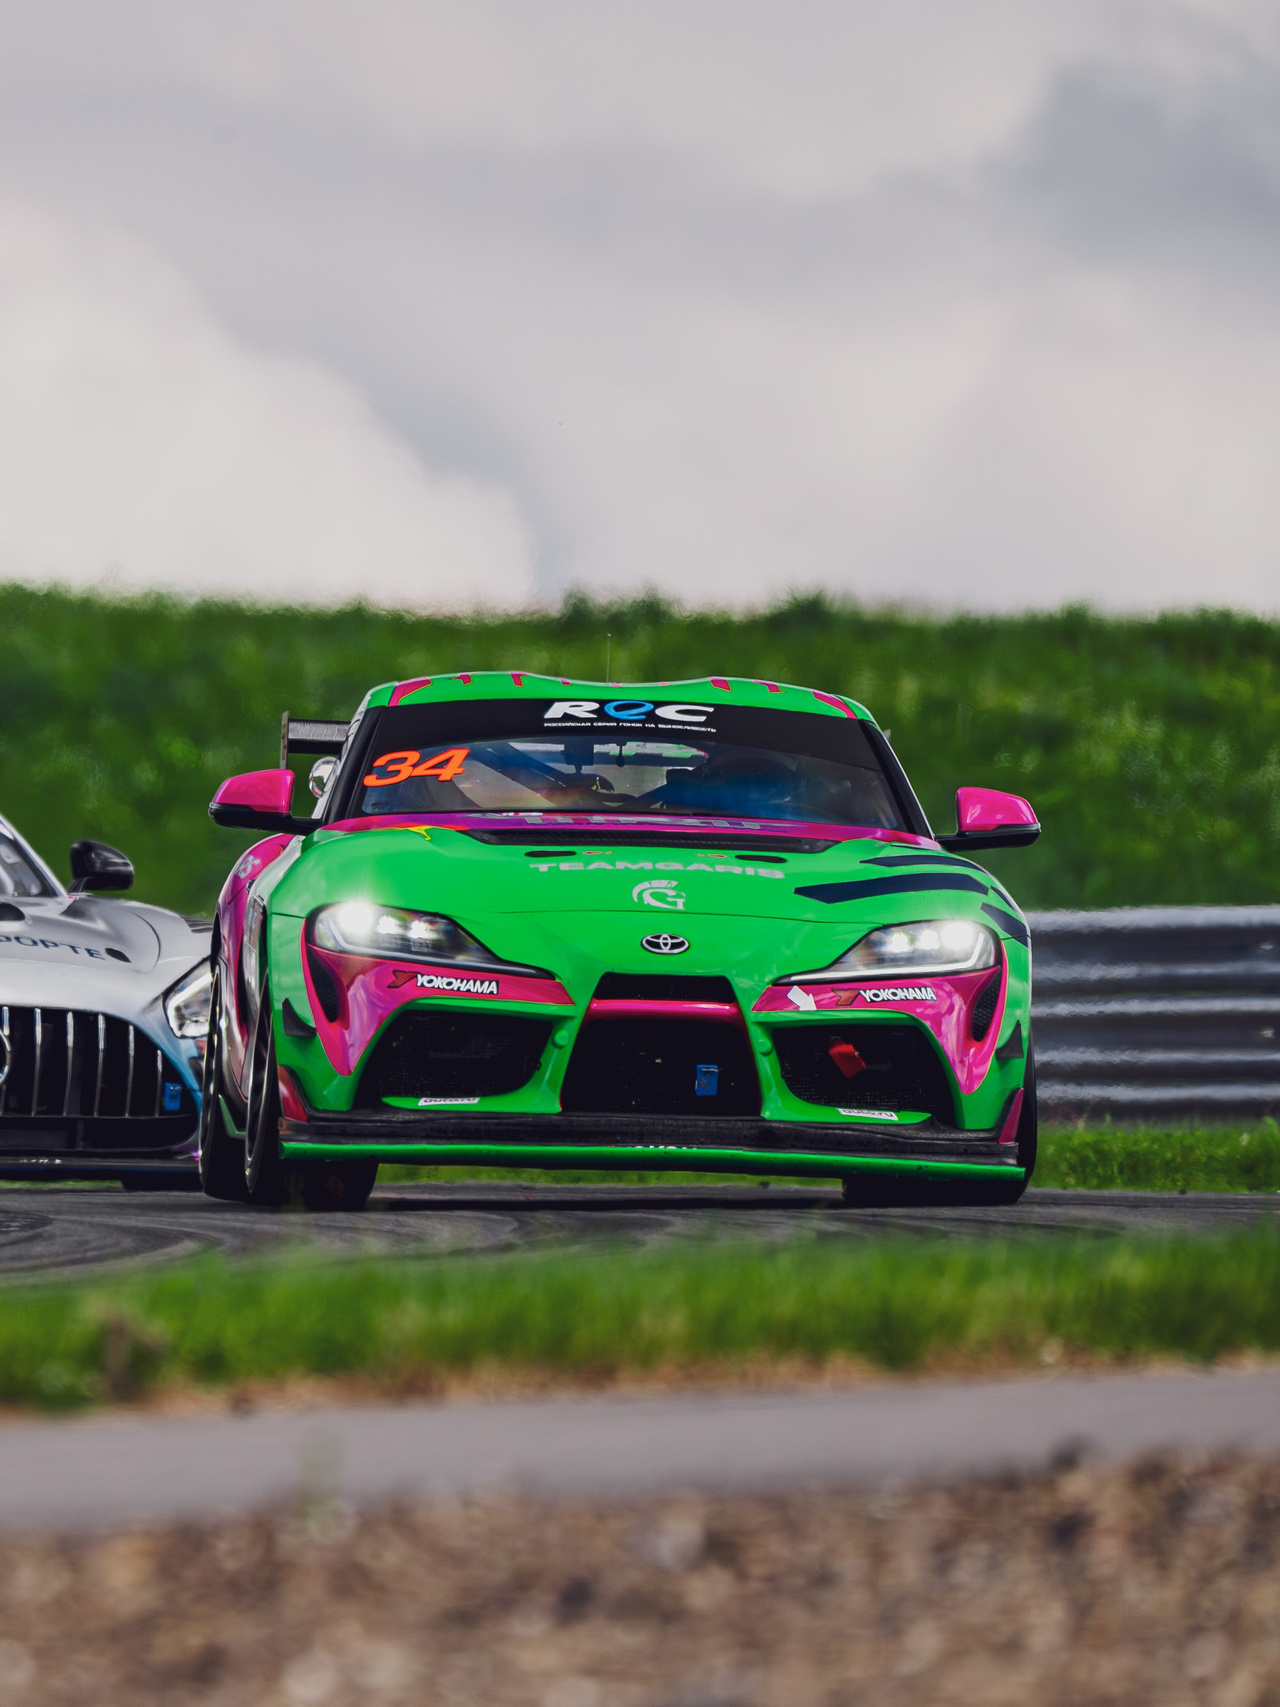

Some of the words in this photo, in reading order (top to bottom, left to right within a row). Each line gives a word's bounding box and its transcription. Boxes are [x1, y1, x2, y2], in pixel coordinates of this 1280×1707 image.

[362, 746, 471, 787] 34
[529, 860, 786, 879] TEAMGARIS
[416, 974, 498, 994] YOKOHAMA
[859, 986, 937, 1003] YOKOHAMA
